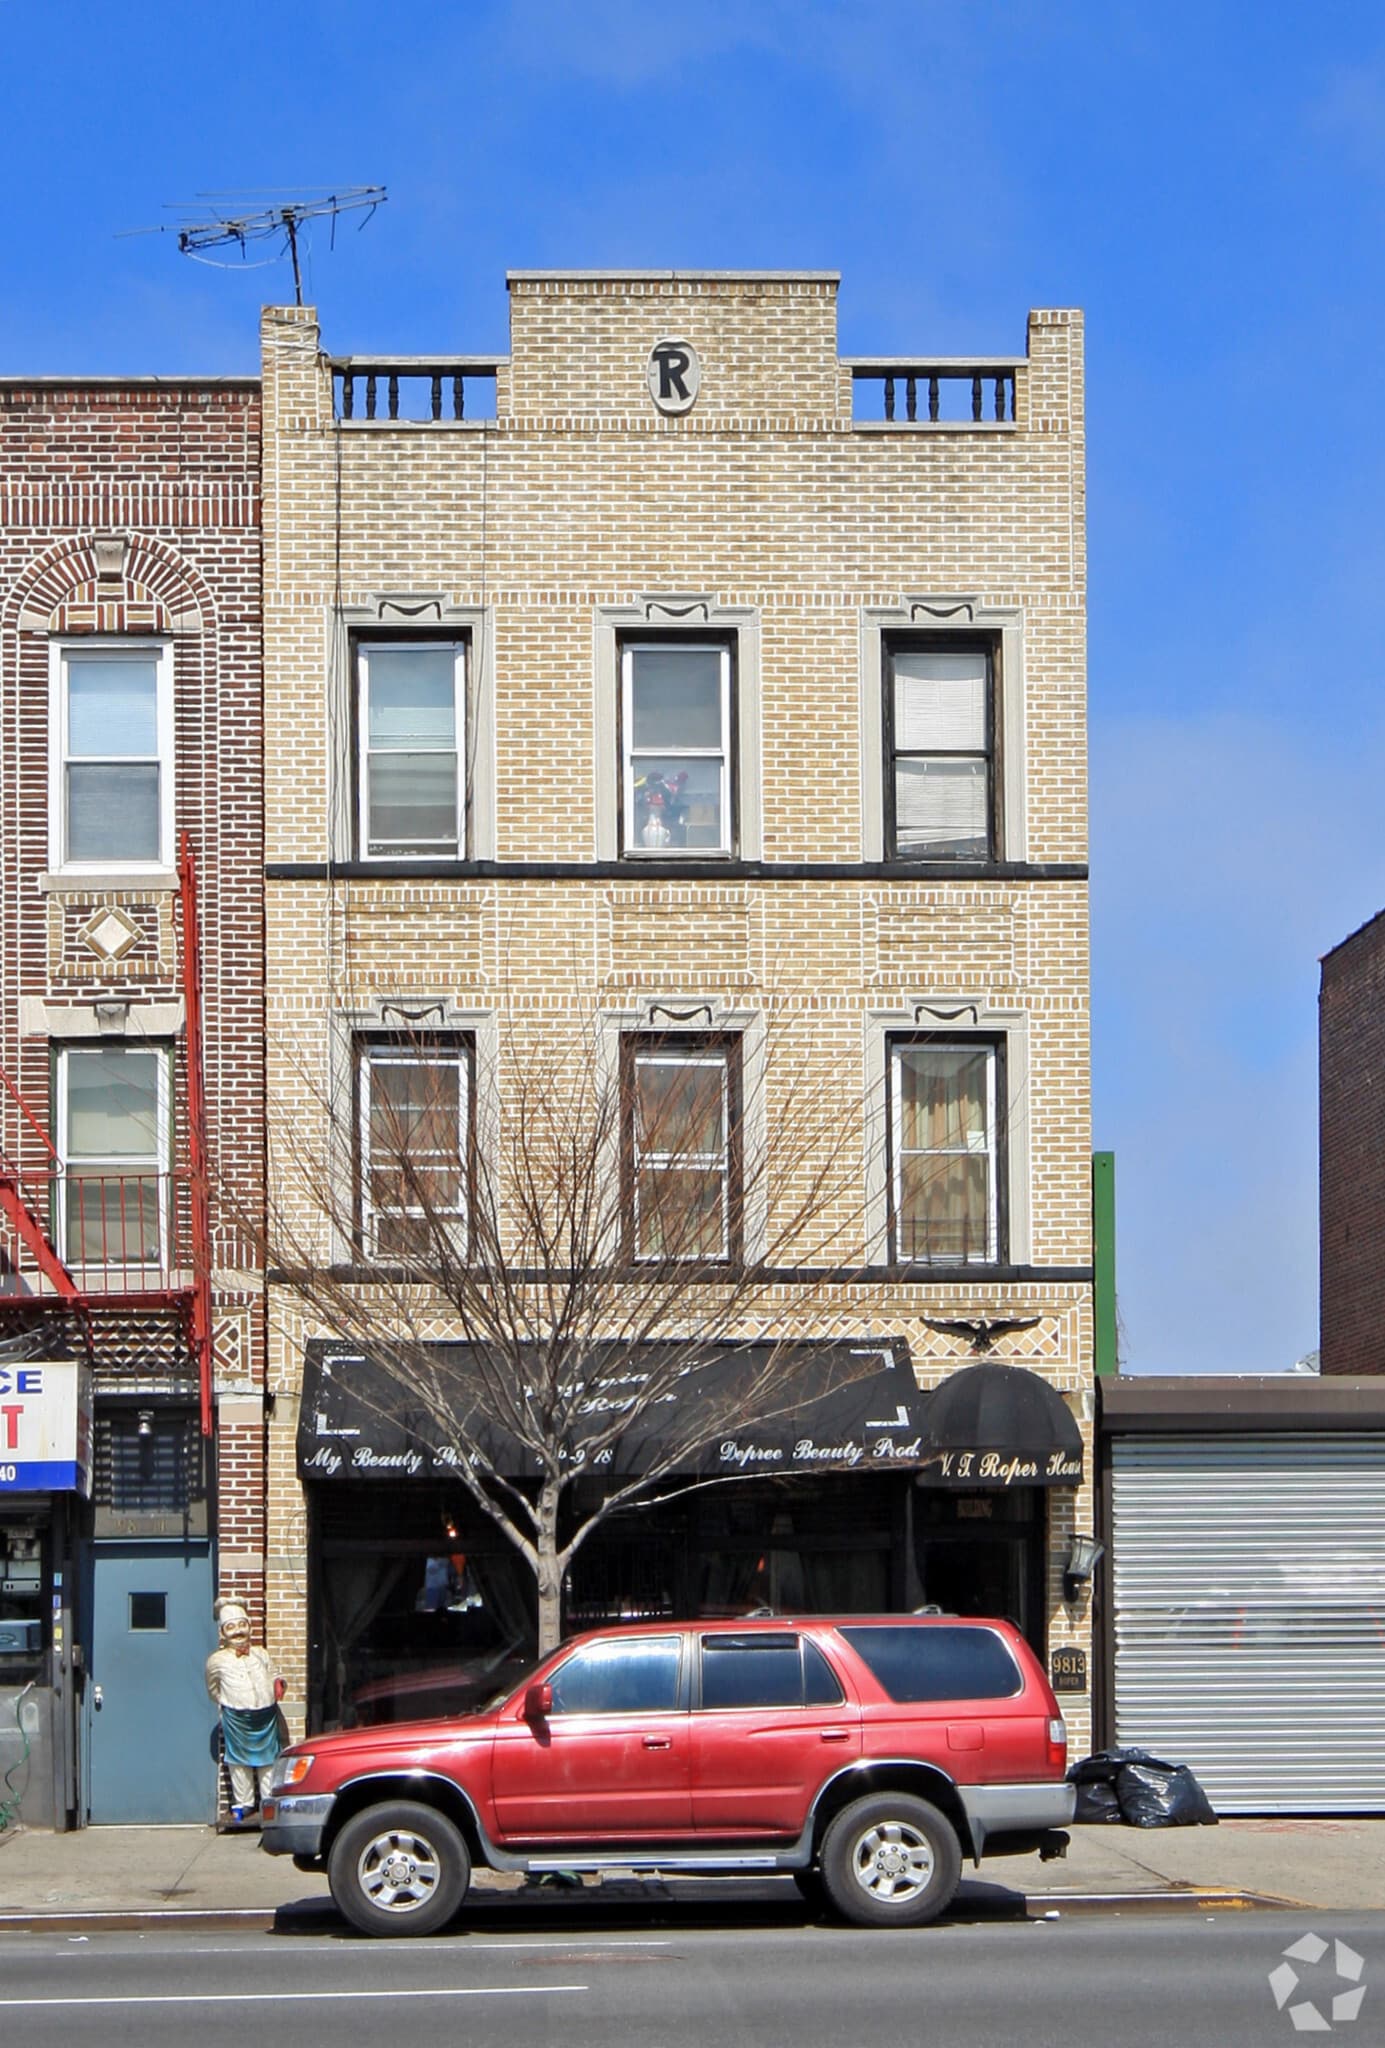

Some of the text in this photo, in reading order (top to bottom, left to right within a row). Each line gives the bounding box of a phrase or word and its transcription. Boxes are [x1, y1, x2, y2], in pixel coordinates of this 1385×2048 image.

[652, 350, 691, 400] R
[304, 1447, 342, 1475] My
[351, 1446, 423, 1474] Beauty
[792, 1439, 864, 1466] Beauty
[872, 1437, 922, 1458] Prod.
[979, 1452, 1038, 1485] Roper
[1053, 1656, 1085, 1674] 9813
